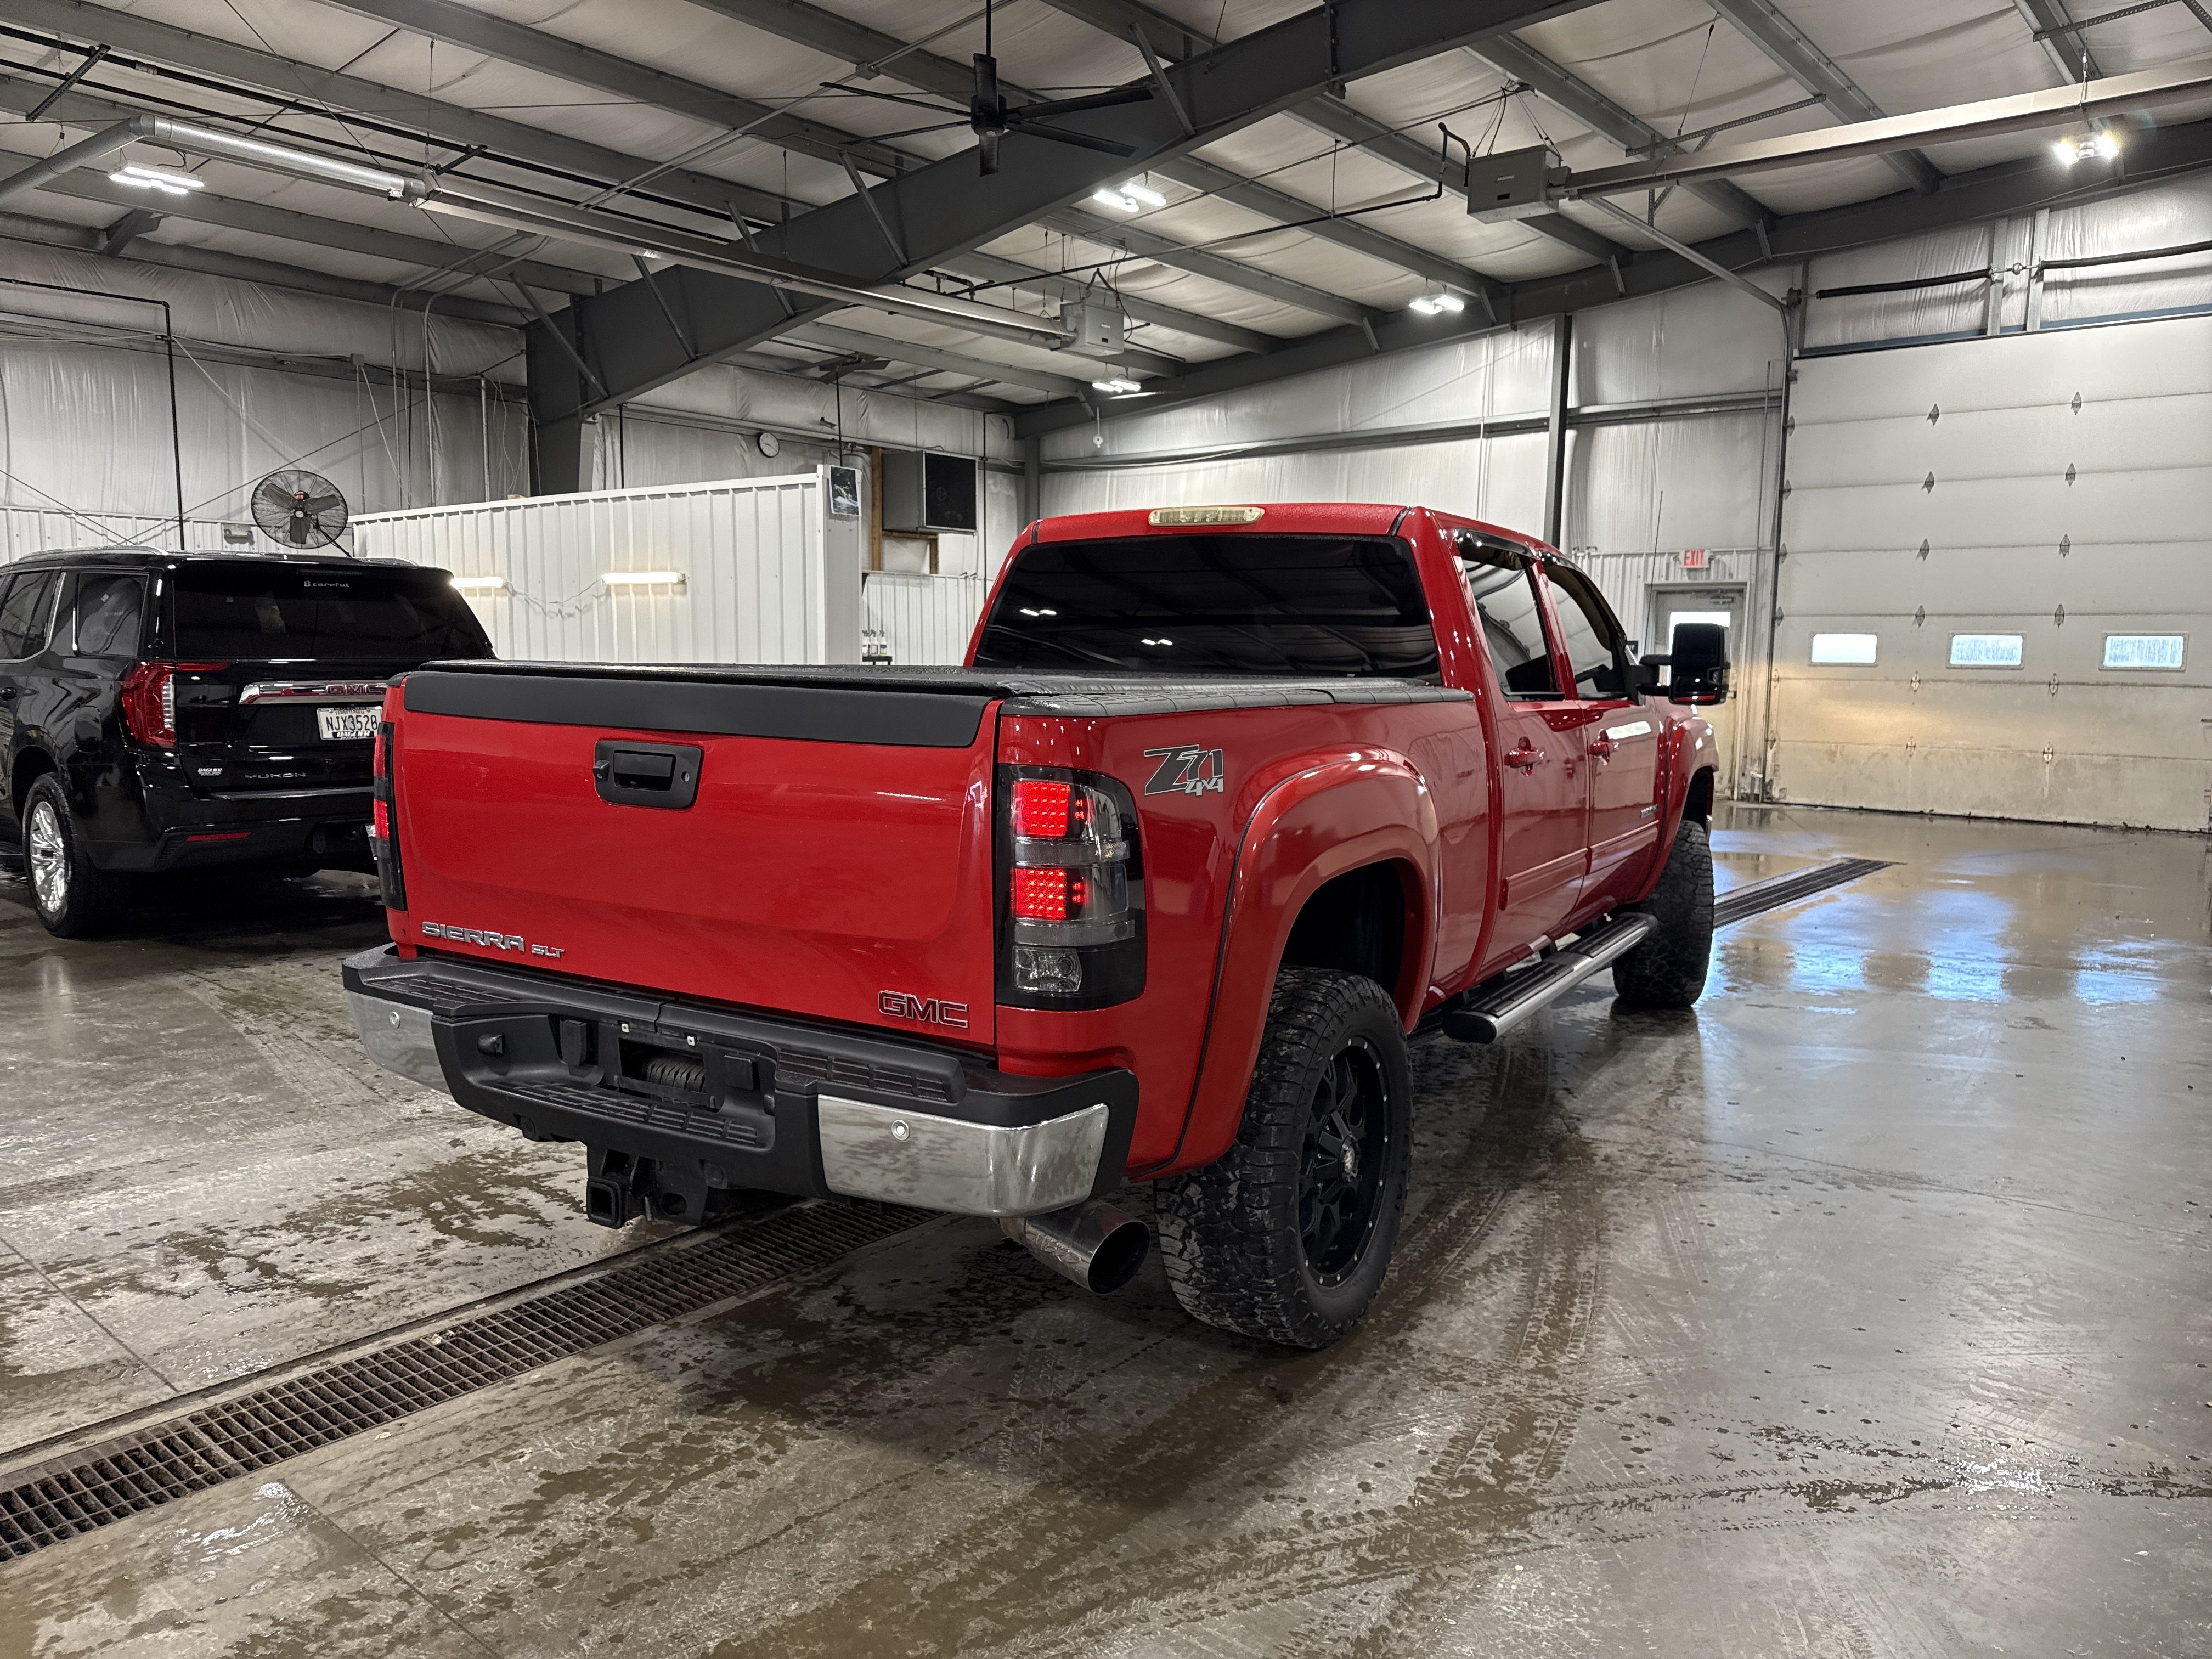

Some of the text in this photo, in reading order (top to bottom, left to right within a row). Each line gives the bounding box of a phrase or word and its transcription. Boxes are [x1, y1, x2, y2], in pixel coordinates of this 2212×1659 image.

[1684, 549, 1705, 567] EXIT
[325, 684, 387, 695] GMC
[1144, 744, 1224, 795] Z71
[421, 921, 565, 958] SIERRA SLT
[878, 990, 968, 1029] GMC
